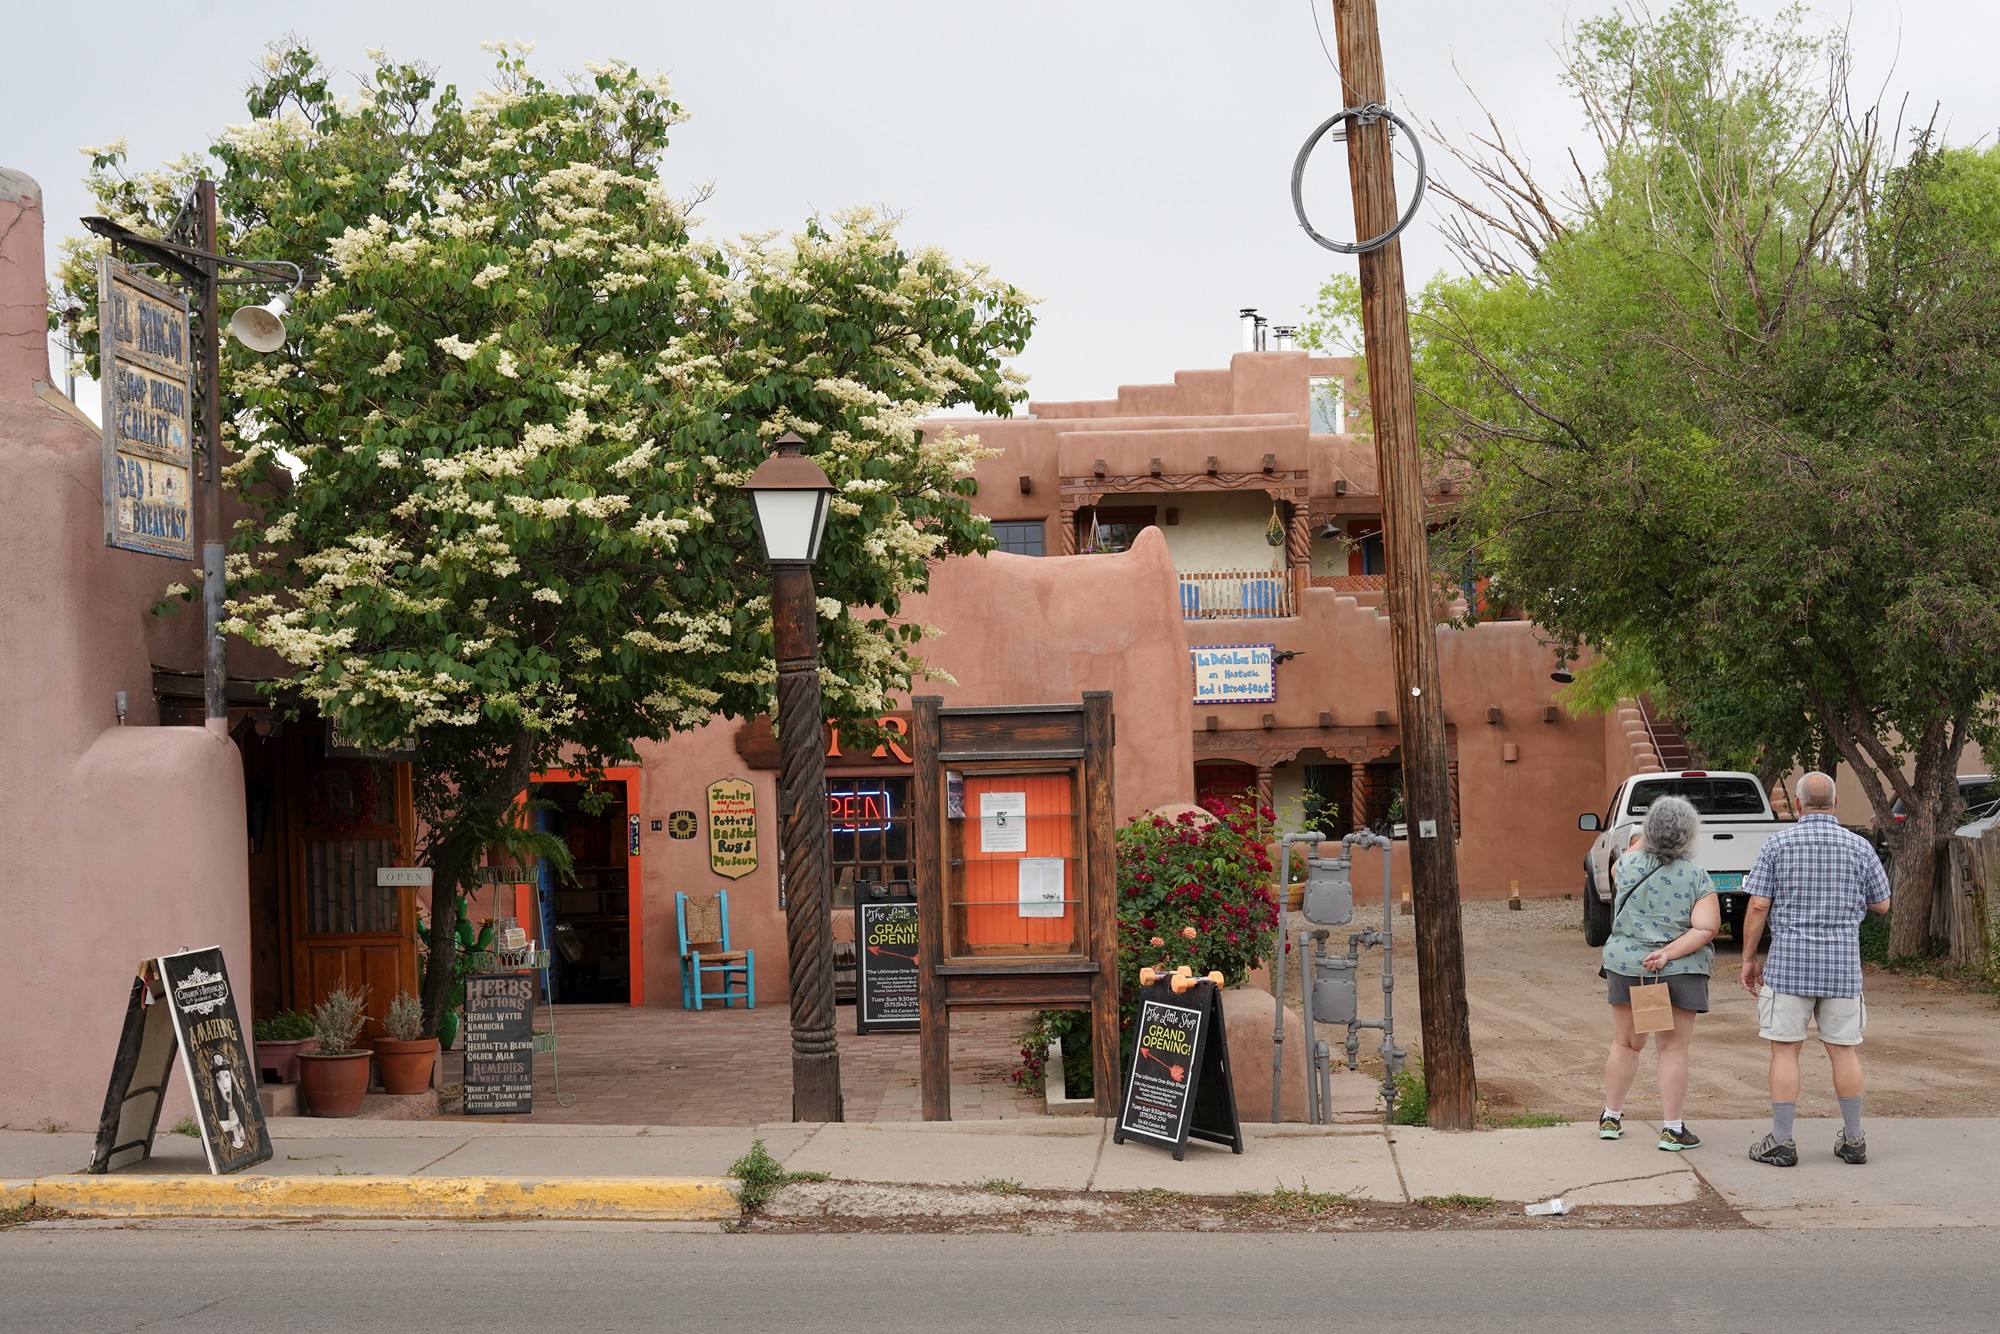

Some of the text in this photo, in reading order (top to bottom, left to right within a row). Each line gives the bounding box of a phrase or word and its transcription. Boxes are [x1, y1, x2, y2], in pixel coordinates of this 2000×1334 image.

[118, 456, 144, 500] BED
[133, 501, 187, 541] BREAKFAST
[1198, 654, 1210, 666] La
[1251, 650, 1270, 664] Inn
[1224, 670, 1259, 678] Historic
[1199, 684, 1215, 694] Bed
[1223, 682, 1270, 694] Breakfast
[712, 788, 750, 801] Jewelry
[826, 796, 886, 828] PEN
[714, 816, 753, 826] Pottery
[718, 840, 751, 854] Rugs
[713, 855, 756, 867] Museum
[386, 873, 422, 881] OPEN
[866, 908, 884, 922] The
[869, 934, 918, 945] OPENIN
[466, 979, 532, 1000] HERBS
[472, 997, 525, 1011] POTIONS
[468, 1012, 522, 1022] HERBAL WATER
[1146, 1006, 1196, 1031] The Little Shop
[468, 1022, 504, 1032] KOMBUCHA
[1149, 1025, 1185, 1042] GRAND
[189, 1018, 238, 1052] AMAZING
[468, 1033, 487, 1041] KEFIR
[1143, 1036, 1192, 1056] OPENING!
[467, 1052, 514, 1061] GOLDEN MILK
[473, 1063, 524, 1075] REMEDIES
